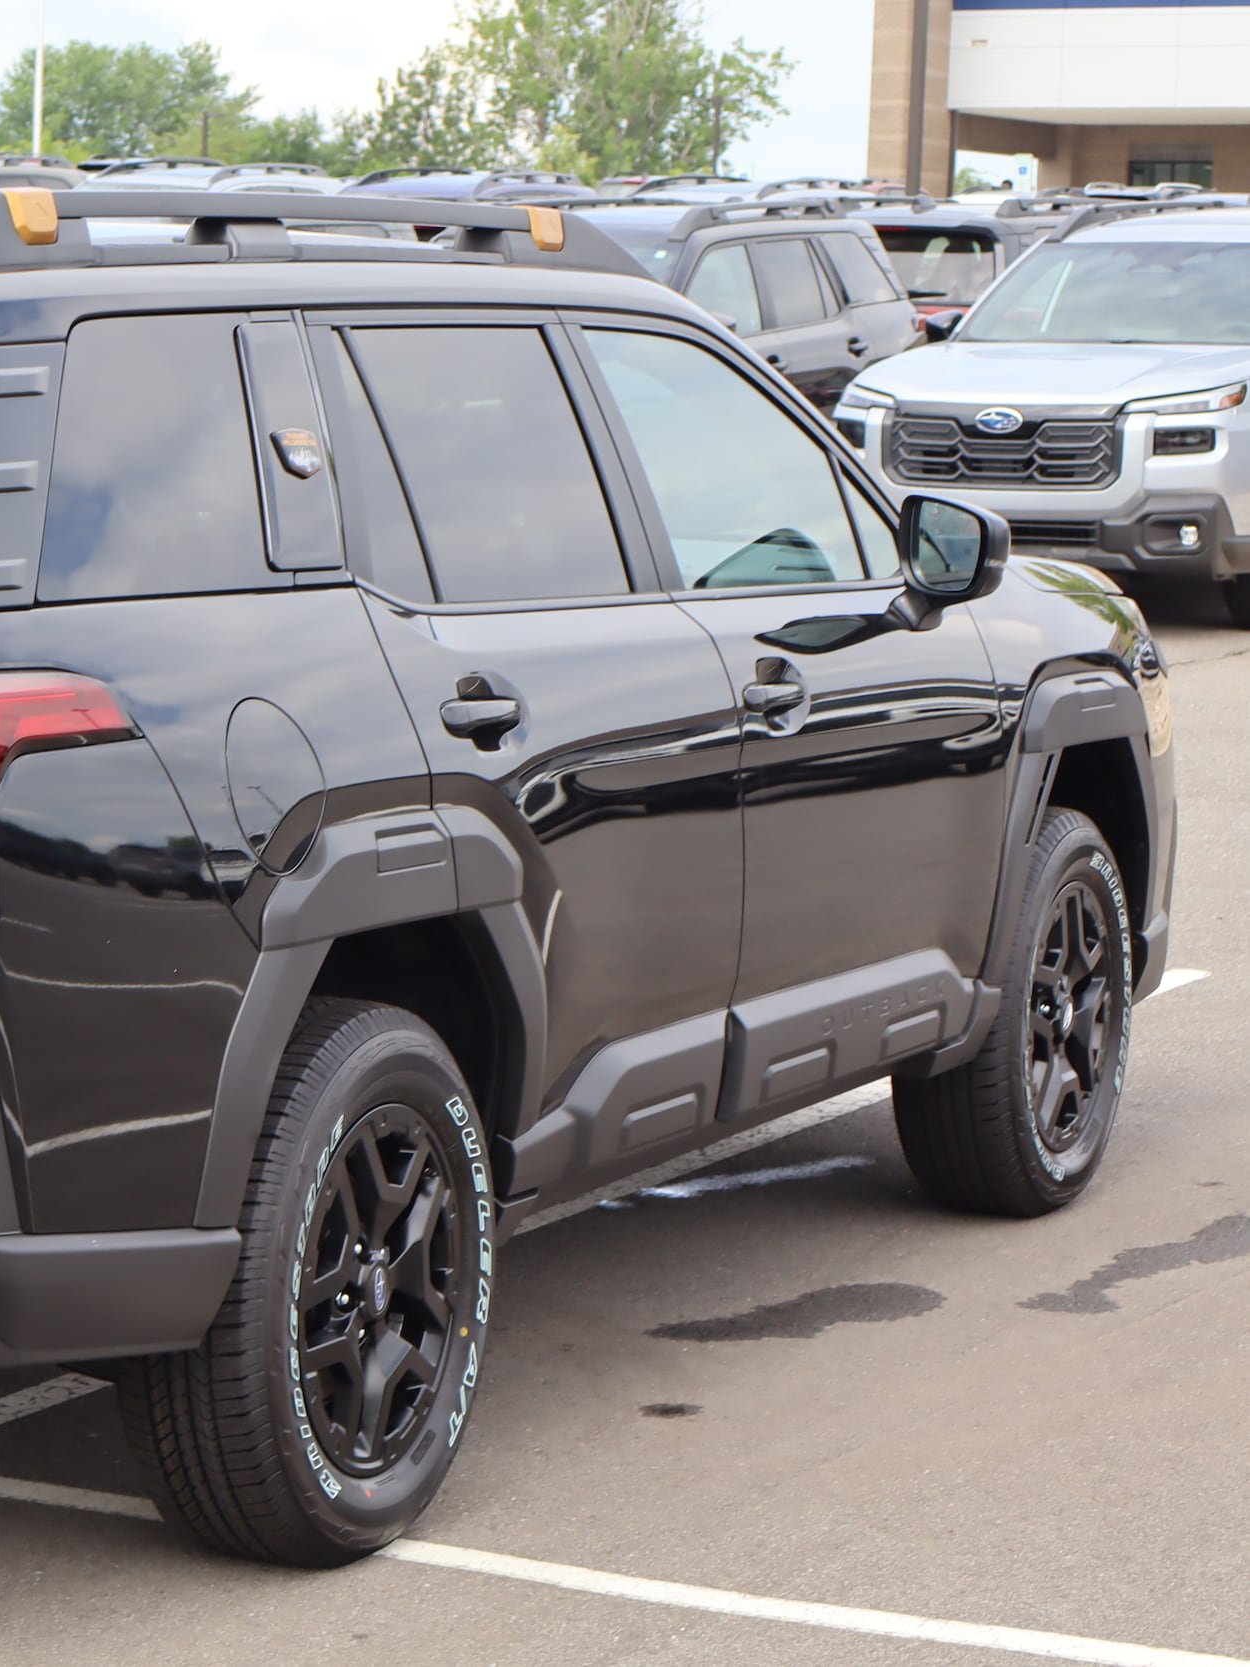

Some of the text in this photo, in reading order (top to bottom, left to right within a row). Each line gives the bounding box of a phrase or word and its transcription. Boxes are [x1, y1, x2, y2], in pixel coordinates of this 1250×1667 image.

[821, 978, 945, 1037] OUTBACK
[289, 1113, 345, 1500] BRIDGESTONE
[445, 1095, 492, 1449] DUELER A/T
